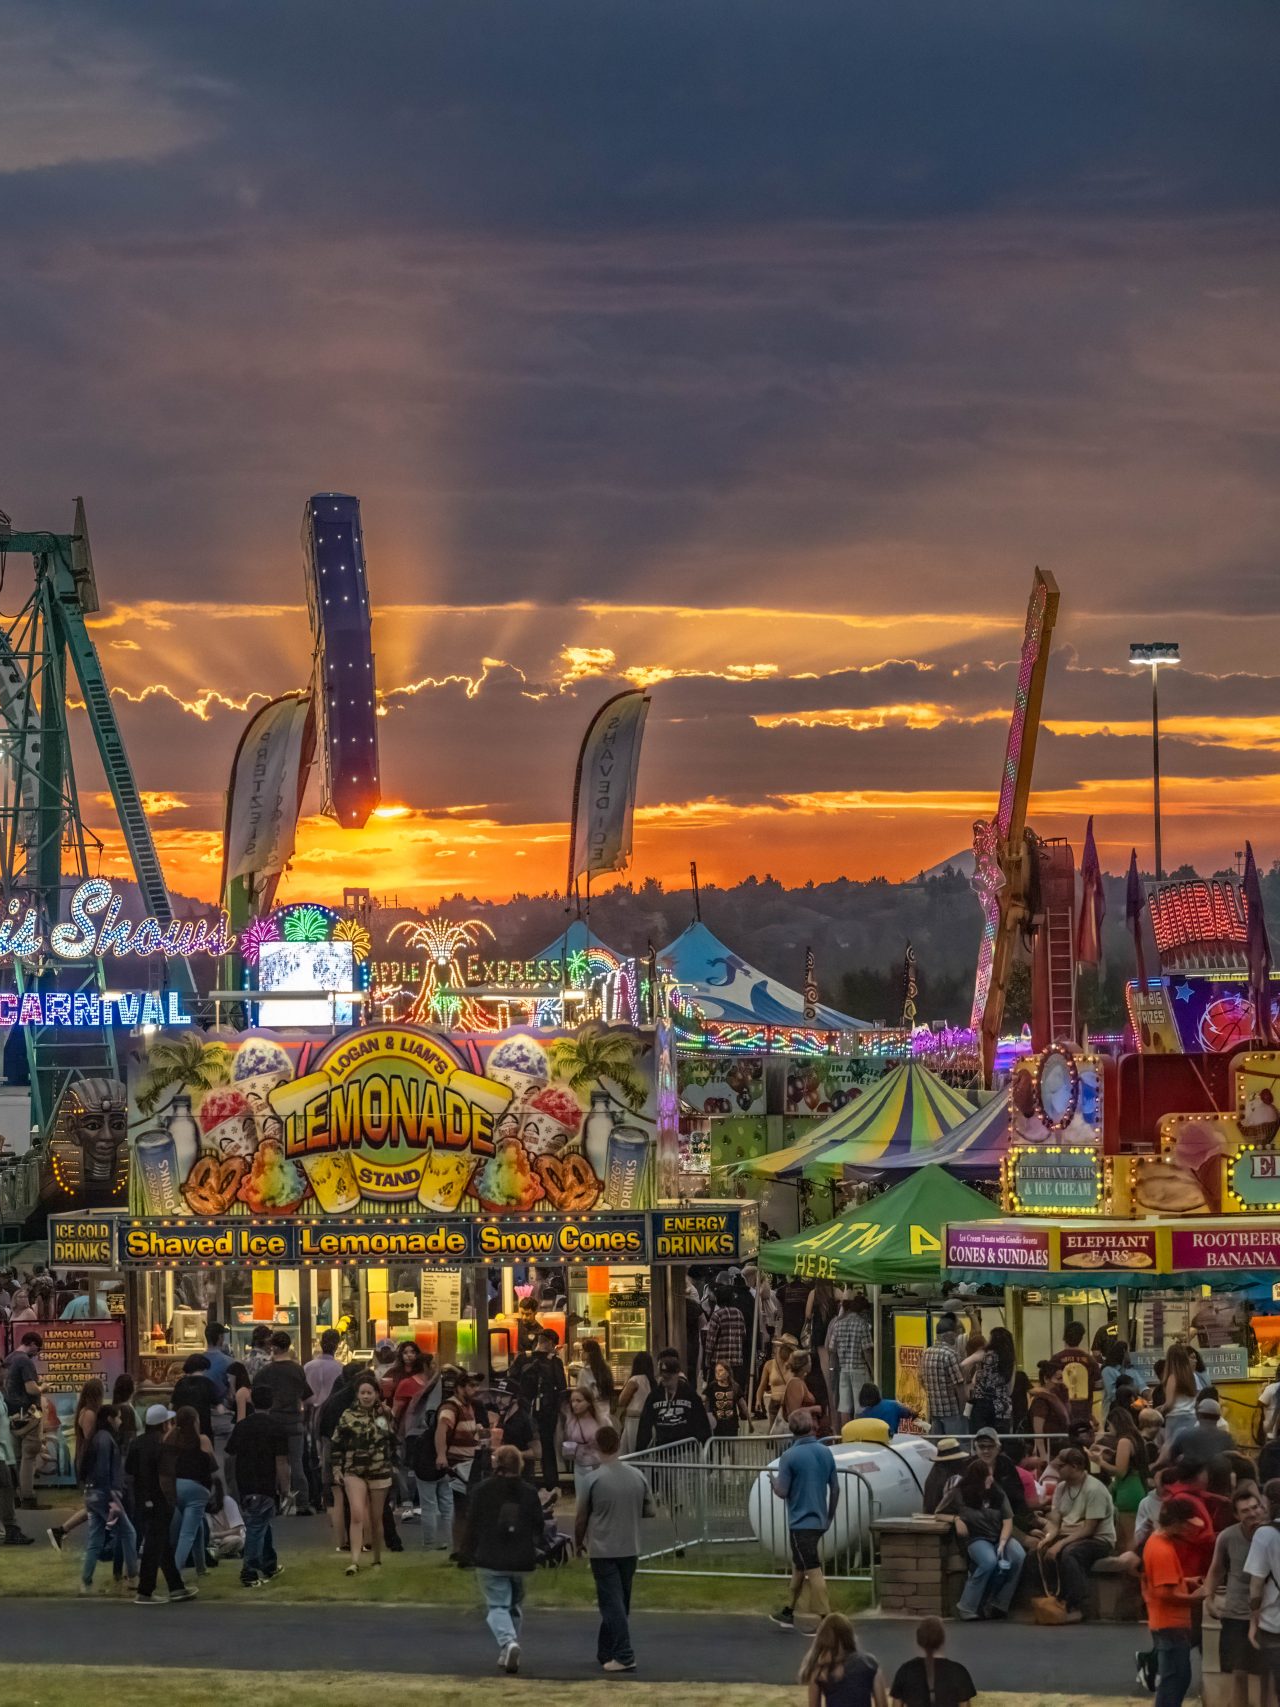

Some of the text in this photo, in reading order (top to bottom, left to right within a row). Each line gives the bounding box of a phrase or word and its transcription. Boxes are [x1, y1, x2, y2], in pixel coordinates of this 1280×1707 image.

[51, 878, 237, 958] Shows
[467, 954, 562, 982] EXPRESS
[329, 1036, 448, 1077] LOGAN & LIAM'S
[285, 1073, 497, 1160] LEMONADE
[358, 1167, 421, 1188] STAND
[607, 1156, 623, 1206] ENERGY
[1020, 1166, 1096, 1179] ELEPHANT EARS
[158, 1159, 176, 1209] DRINKS
[620, 1159, 638, 1209] DRINKS
[1024, 1182, 1091, 1197] & ICE CREAM
[55, 1223, 109, 1238] ICE COLD
[663, 1215, 727, 1234] ENERGY
[126, 1229, 286, 1258] Shaved Ice
[300, 1226, 467, 1257] Lemonade
[479, 1224, 642, 1254] Snow Cones
[657, 1233, 735, 1258] DRINKS
[791, 1222, 898, 1256] ATM
[1067, 1235, 1150, 1249] ELEPHANT
[1192, 1232, 1280, 1248] ROOTBEER
[54, 1241, 111, 1264] DRINKS
[949, 1246, 1049, 1267] CONES & SUNDAES
[1206, 1252, 1277, 1267] BANANA
[793, 1252, 841, 1280] HERE
[44, 1330, 95, 1339] LEMONADE
[66, 1341, 102, 1349] SHAVED
[104, 1340, 118, 1348] ICE
[39, 1352, 101, 1360] SNOW CONES
[48, 1363, 91, 1371] PRETZELS
[1206, 1366, 1241, 1376] LOATS
[39, 1374, 70, 1382] NERGY
